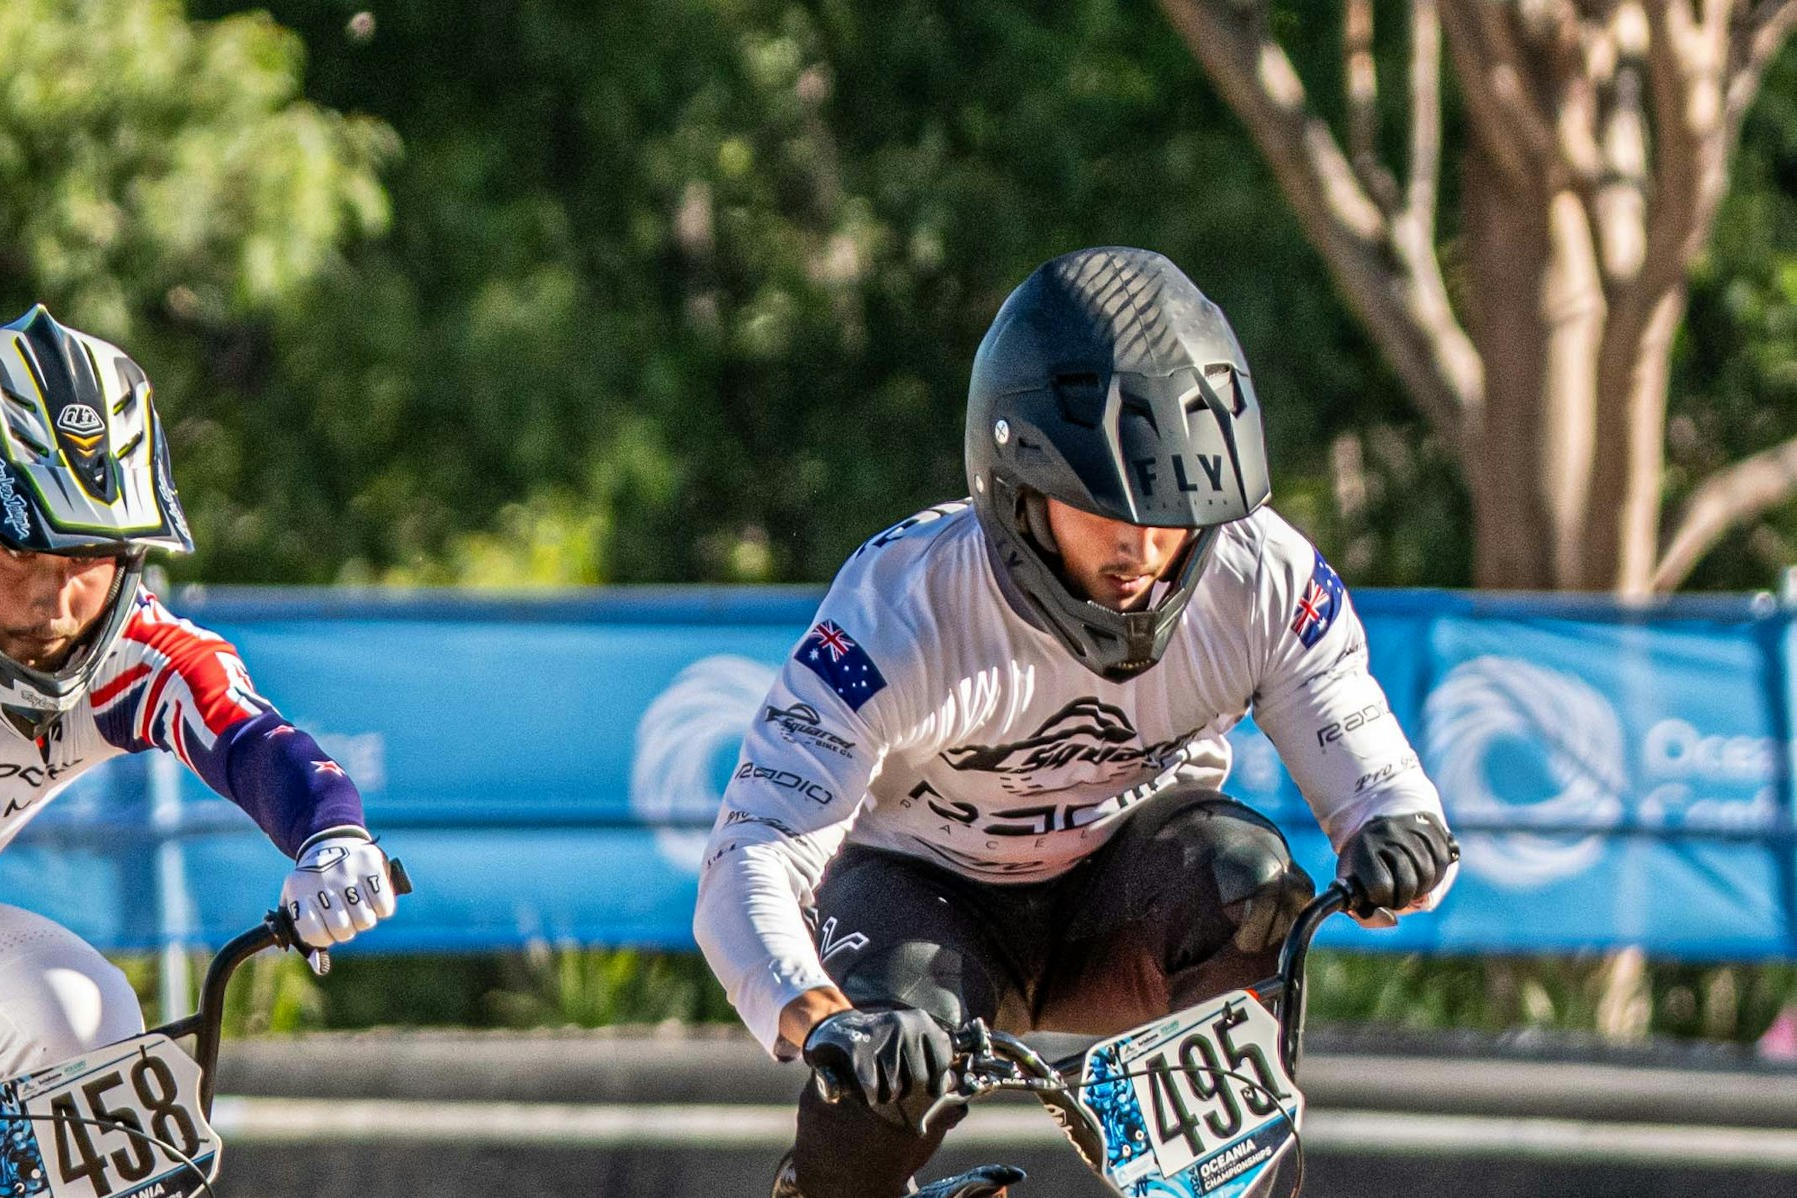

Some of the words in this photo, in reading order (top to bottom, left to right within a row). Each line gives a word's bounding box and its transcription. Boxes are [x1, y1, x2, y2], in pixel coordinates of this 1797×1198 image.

[1132, 453, 1222, 496] FLY
[289, 874, 381, 921] FIST
[1145, 1006, 1282, 1158] 495
[51, 1055, 201, 1198] 458
[1200, 1138, 1257, 1178] OCEANIA
[1204, 1145, 1273, 1192] CHAMPIONSHIPS
